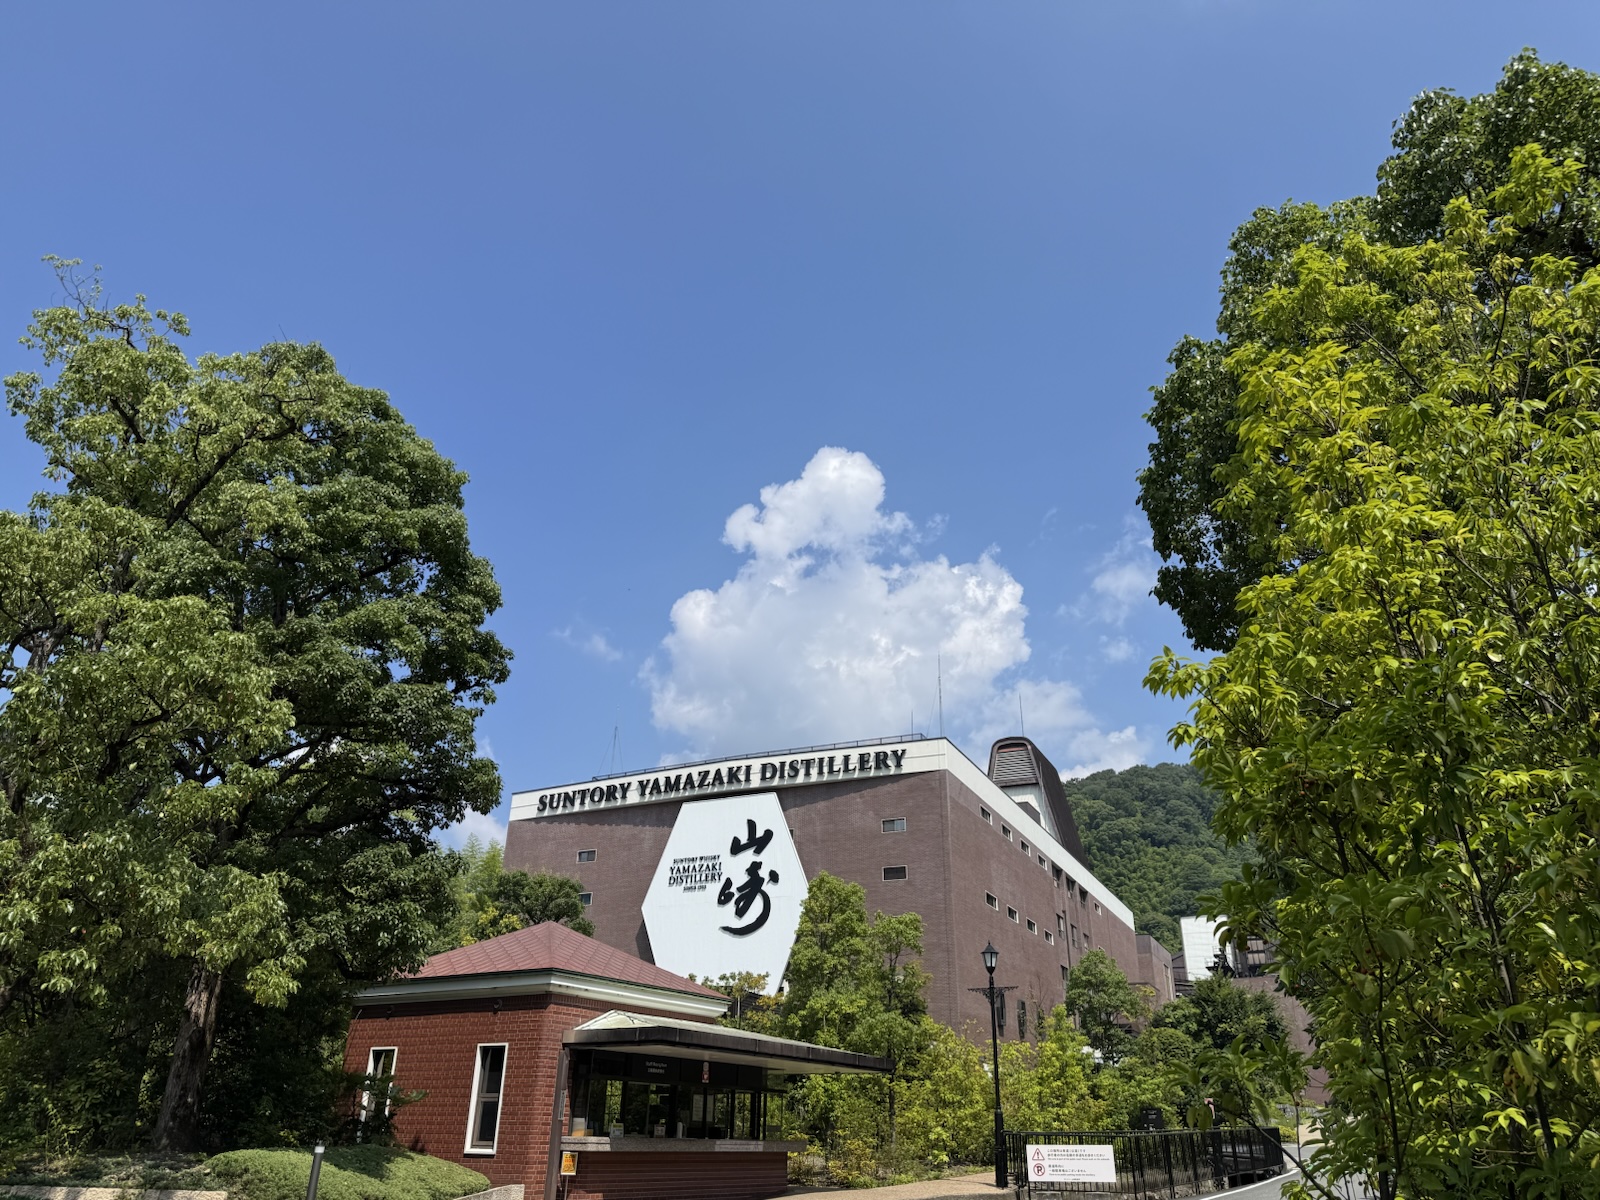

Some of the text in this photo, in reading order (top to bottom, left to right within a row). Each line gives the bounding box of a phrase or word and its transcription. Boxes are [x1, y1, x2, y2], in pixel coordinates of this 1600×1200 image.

[537, 749, 907, 812] SUNTORY YAMAZAKI DISTILLERY
[670, 861, 722, 875] YAMAZAKI
[668, 872, 723, 886] DISTILLERY
